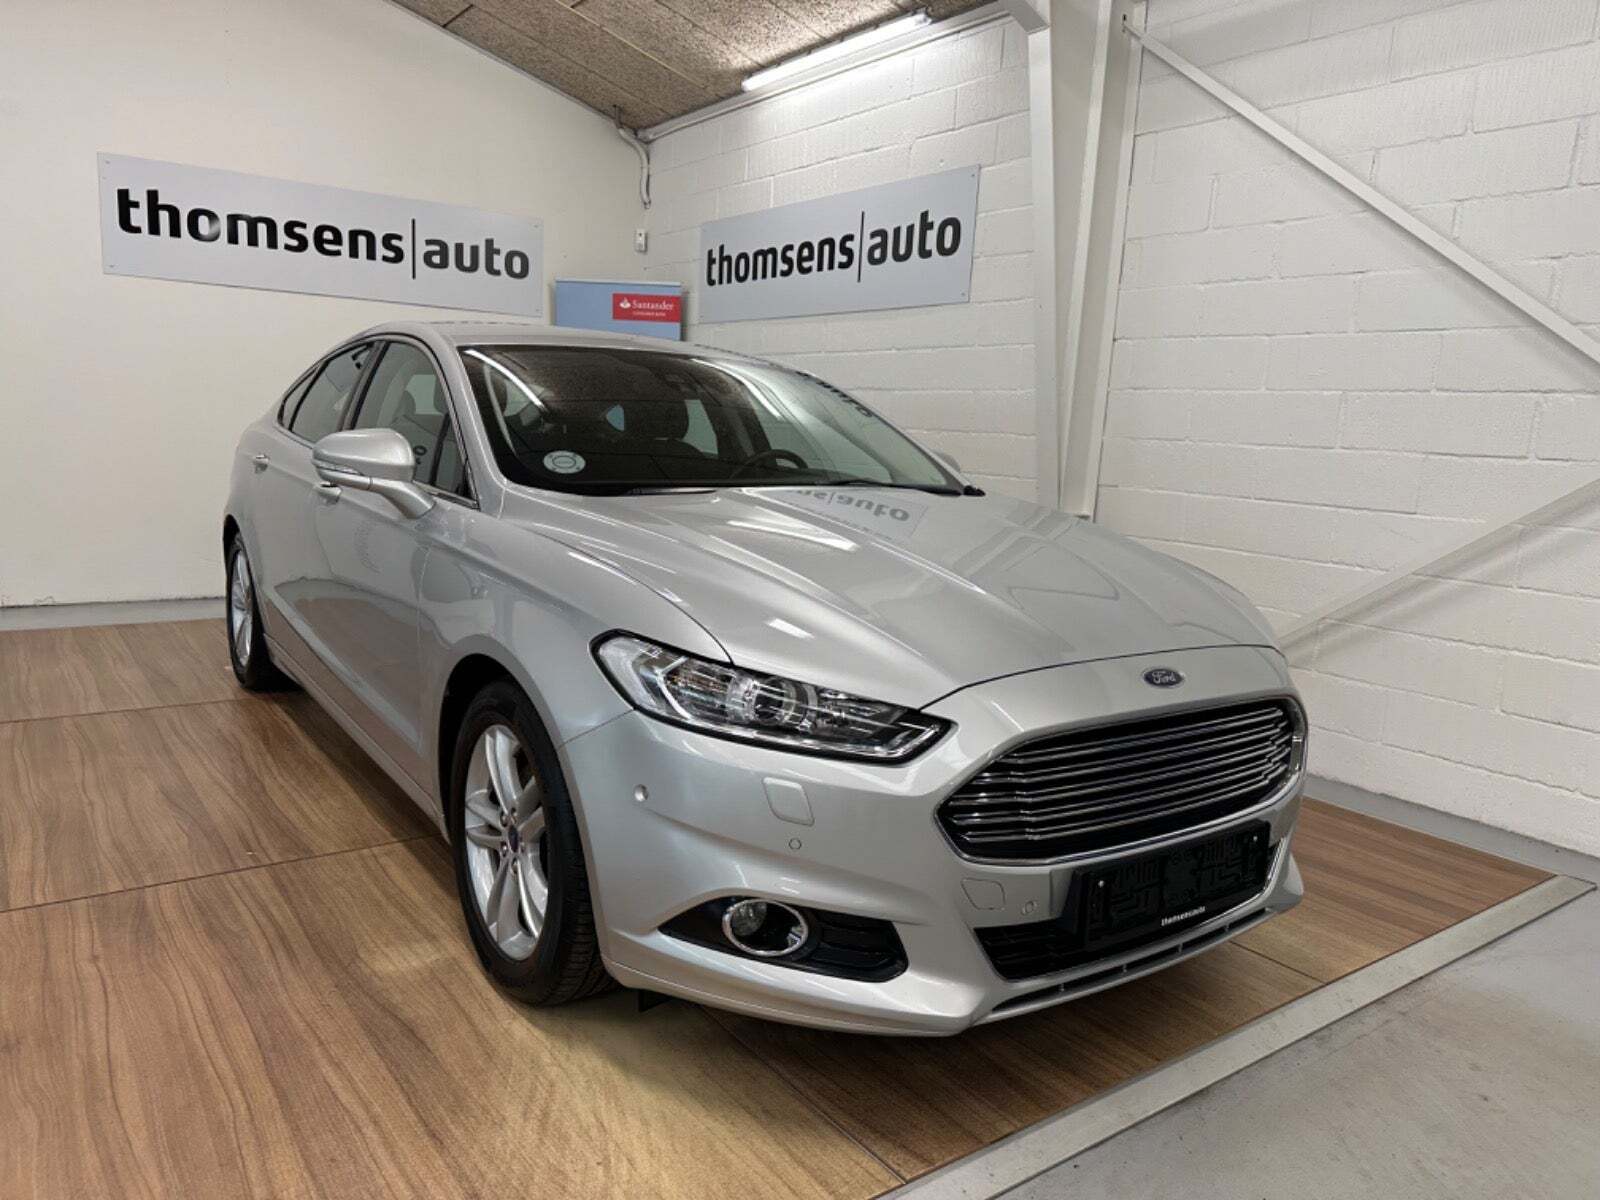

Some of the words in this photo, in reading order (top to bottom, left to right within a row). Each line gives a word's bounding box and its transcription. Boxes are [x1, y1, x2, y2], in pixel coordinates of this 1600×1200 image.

[117, 188, 404, 264] thomsens
[423, 238, 529, 280] auto
[706, 233, 855, 287] thomsens
[867, 210, 961, 266] auto
[631, 299, 673, 311] Santander
